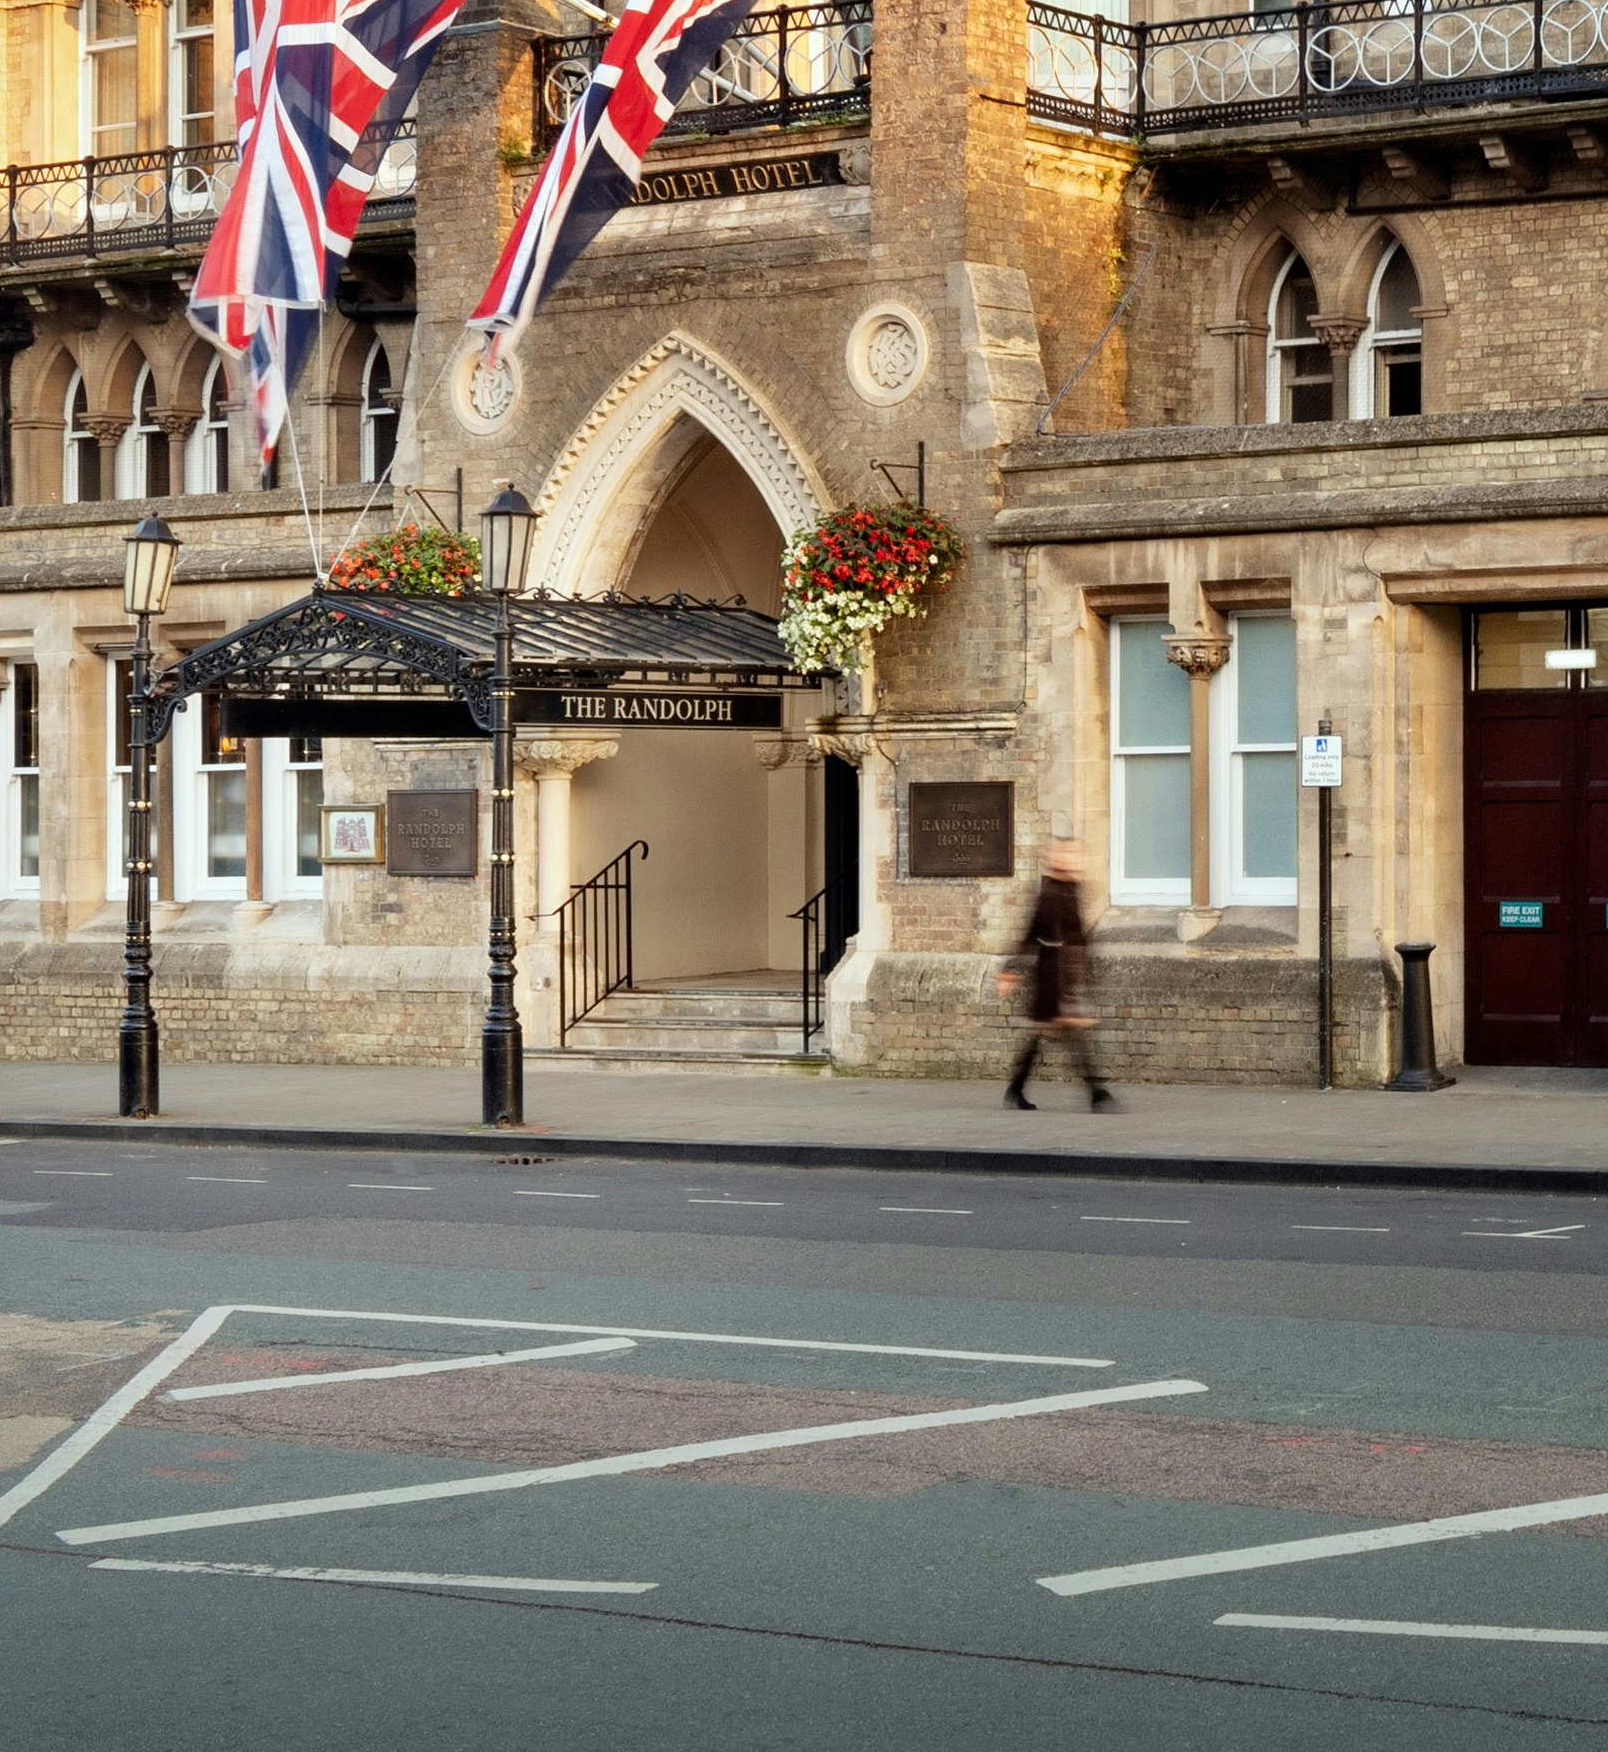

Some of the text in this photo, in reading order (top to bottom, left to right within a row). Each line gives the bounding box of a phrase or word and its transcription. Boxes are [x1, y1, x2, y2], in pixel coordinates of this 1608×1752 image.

[730, 160, 823, 193] HOTEL
[561, 695, 733, 721] THE RANDOLPH
[422, 808, 440, 817] THE
[951, 803, 971, 812] THE
[397, 823, 465, 835] RANDOLPH
[921, 819, 1000, 831] RANDOLPH
[411, 837, 451, 849] HOTEL
[937, 834, 984, 846] HOTEL
[1502, 906, 1540, 915] FIRE EXIT
[1502, 915, 1540, 923] KEEP CLEAR
